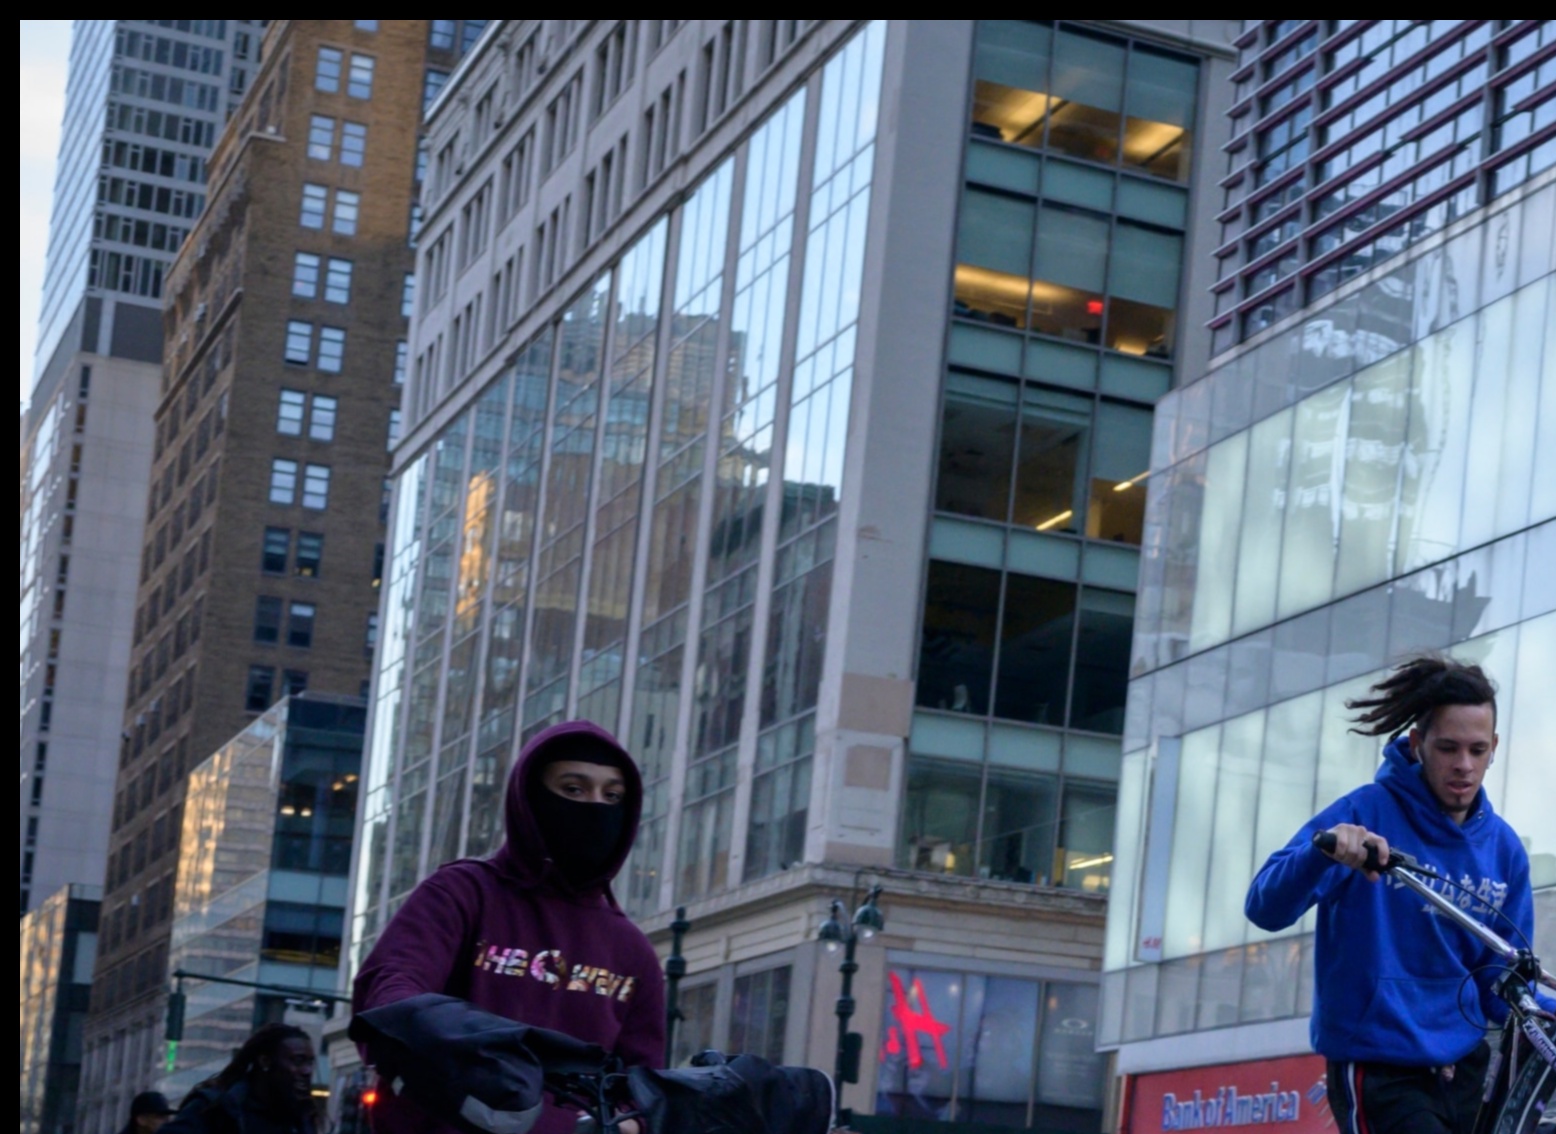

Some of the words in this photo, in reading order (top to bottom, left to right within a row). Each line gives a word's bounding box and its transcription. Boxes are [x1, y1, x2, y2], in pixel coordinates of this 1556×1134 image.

[1161, 1090, 1204, 1131] Bank
[1205, 1086, 1226, 1127] of
[1224, 1081, 1299, 1126] America
